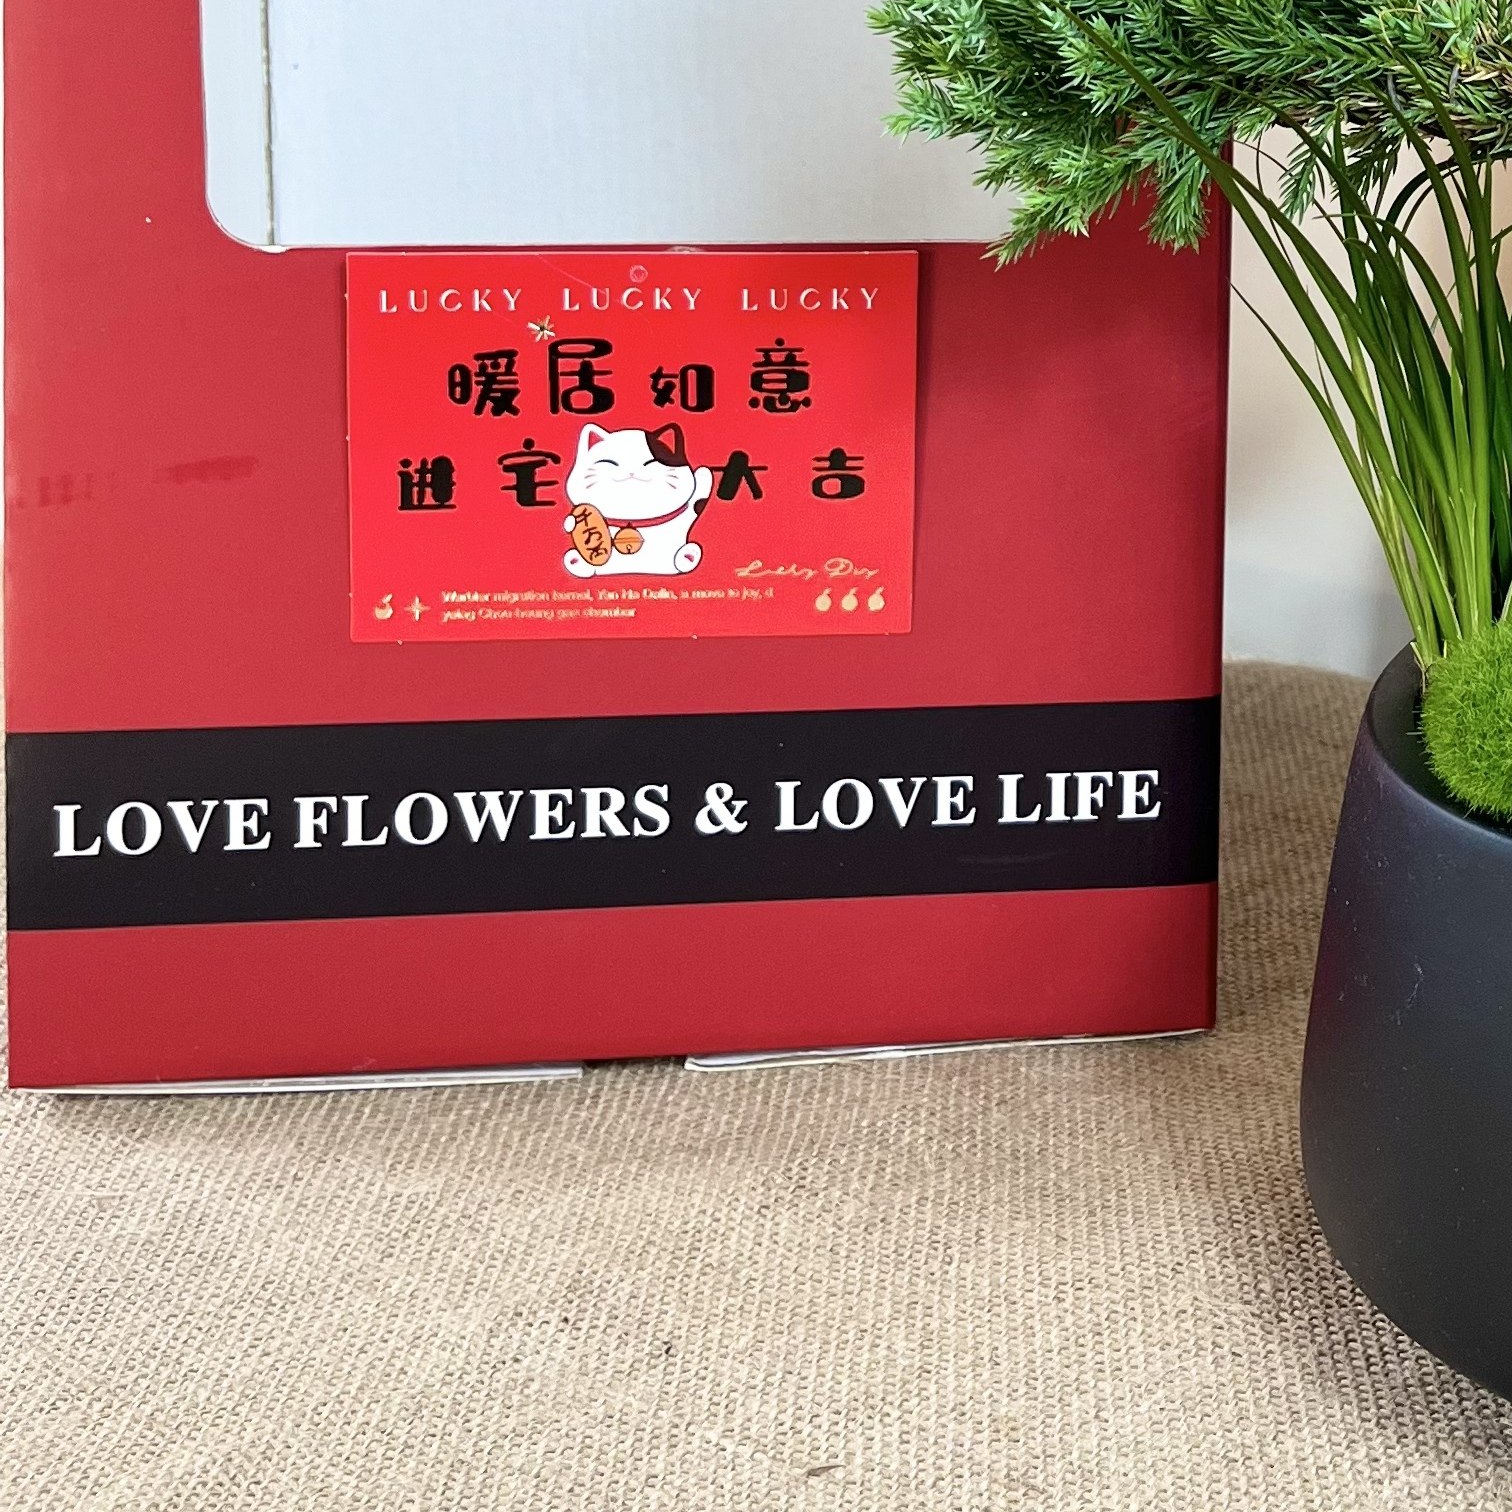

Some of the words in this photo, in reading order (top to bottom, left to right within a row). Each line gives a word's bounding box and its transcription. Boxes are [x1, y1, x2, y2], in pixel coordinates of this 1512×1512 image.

[379, 287, 522, 314] LUCKY
[561, 286, 702, 312] LUCKY
[741, 286, 879, 311] LUCKY
[447, 337, 812, 417] 暖居如意
[52, 798, 271, 858] LOVE
[293, 783, 671, 850] FLOWERS
[694, 781, 749, 835] &
[774, 775, 978, 832] LOVE
[997, 769, 1163, 824] LIFE
